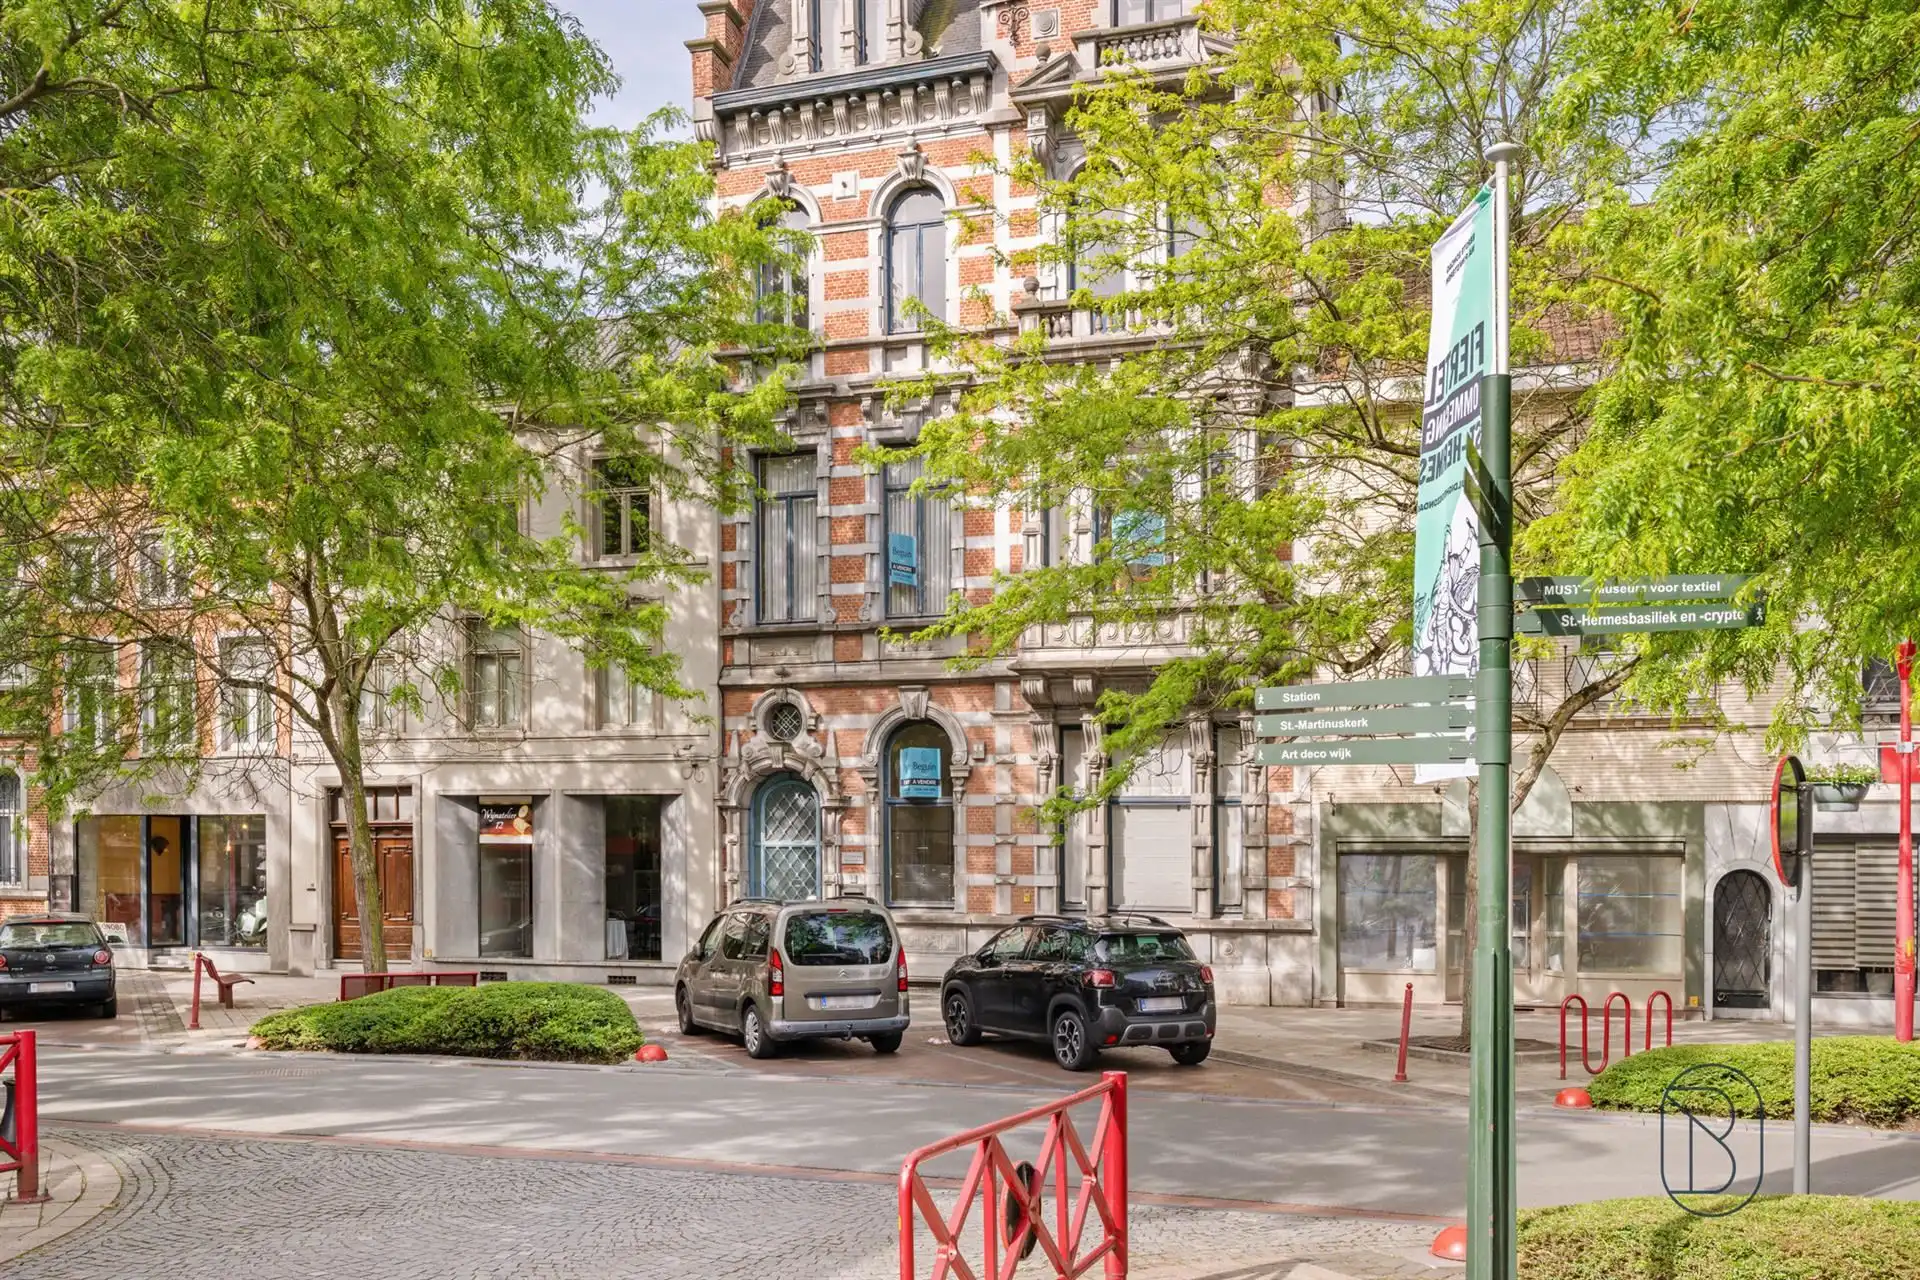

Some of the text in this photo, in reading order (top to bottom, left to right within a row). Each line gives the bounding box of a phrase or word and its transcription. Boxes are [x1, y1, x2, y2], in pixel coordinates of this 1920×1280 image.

[1544, 584, 1581, 596] MUST
[1650, 584, 1680, 593] voor
[1682, 581, 1721, 593] textiel
[1561, 612, 1678, 627] St.-Hermesbasiliek
[1680, 612, 1696, 623] en
[1282, 692, 1321, 703] Station
[1280, 717, 1369, 731] St.-Martinuskerk
[1281, 748, 1351, 761] Art deco wijk
